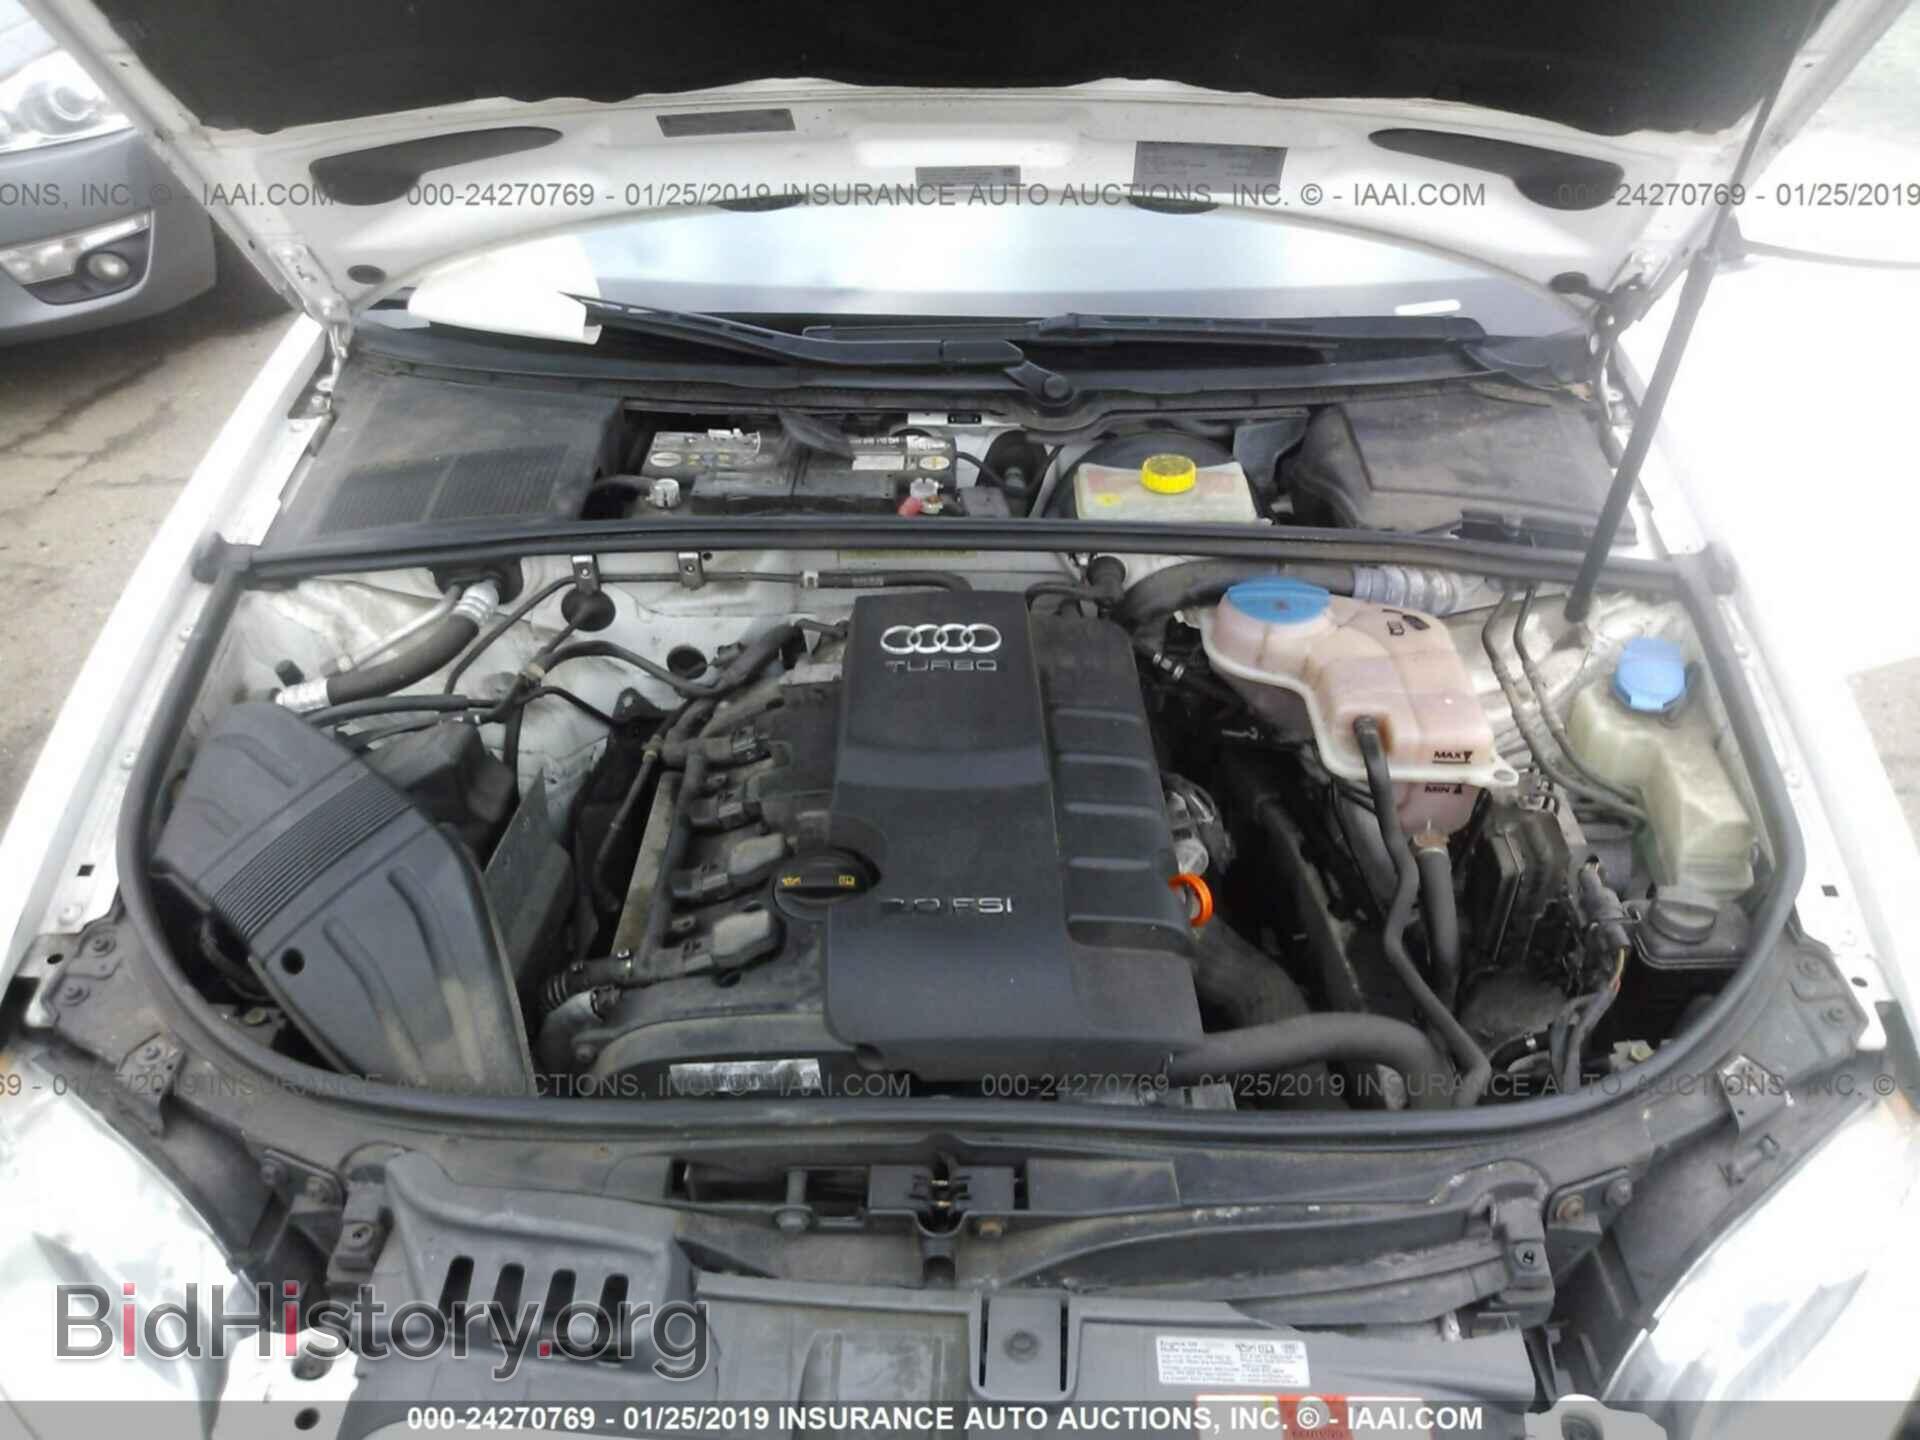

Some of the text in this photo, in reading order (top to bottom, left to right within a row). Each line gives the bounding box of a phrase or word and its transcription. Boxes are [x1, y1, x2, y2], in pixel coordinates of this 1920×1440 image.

[884, 659, 997, 673] TURBO
[1433, 750, 1462, 760] MAX
[952, 896, 1014, 914] FSI
